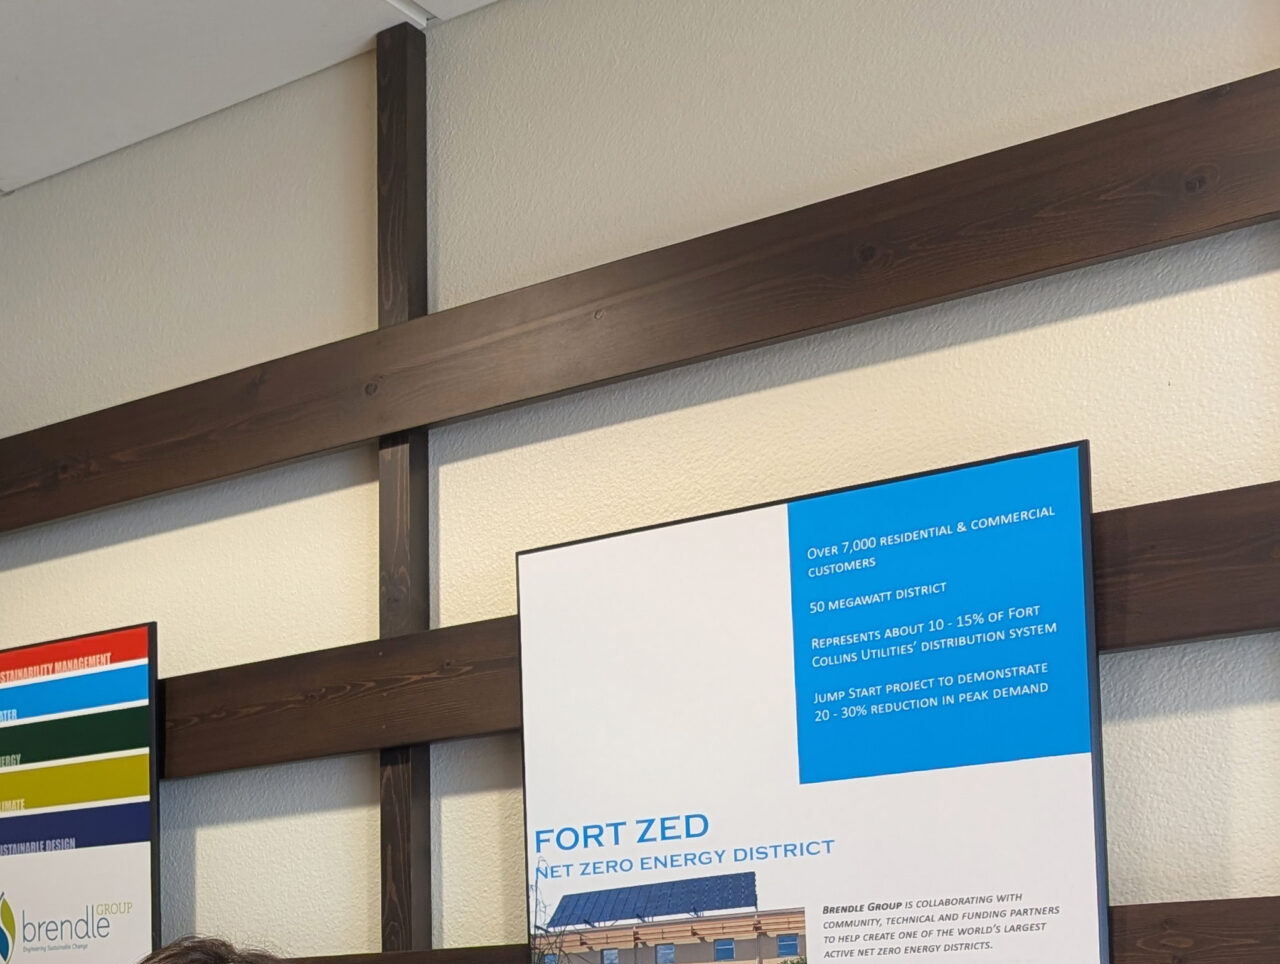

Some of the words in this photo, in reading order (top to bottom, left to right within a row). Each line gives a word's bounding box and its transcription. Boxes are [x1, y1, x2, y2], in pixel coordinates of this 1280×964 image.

[807, 545, 838, 559] OVER
[842, 536, 876, 553] 7,000
[879, 525, 953, 546] RESIDENTIAL
[956, 521, 967, 532] &
[970, 506, 1055, 530] COMMERCIAL
[808, 557, 876, 577] CUSTOMERS
[809, 600, 825, 614] 50
[828, 591, 892, 610] MEGAWATT
[895, 582, 946, 599] DISTRICT
[811, 630, 881, 649] REPRESENTS
[884, 623, 924, 638] ABOUT
[929, 618, 944, 632] 10
[956, 612, 984, 627] 15%
[987, 610, 1003, 622] OF
[1008, 605, 1040, 619] FORT
[812, 652, 858, 667] COLLINS
[861, 640, 916, 660] UTILITIES'
[921, 630, 1005, 651] DISTRIBUTION
[1009, 622, 1057, 638] SYSTEM
[55, 652, 111, 674] MANAGEMENT
[813, 690, 845, 704] JUMP
[848, 685, 882, 699] START
[885, 678, 934, 694] PROJECT
[937, 676, 954, 686] TO
[957, 662, 1047, 684] DEMONSTRATE
[815, 709, 830, 722] 20
[841, 704, 867, 718] 30%
[870, 697, 938, 714] REDUCTION
[942, 694, 954, 705] IN
[958, 690, 988, 702] PEAK
[992, 682, 1048, 699] DEMAND
[46, 838, 76, 852] DESIGN
[535, 821, 626, 853] FORT
[635, 813, 709, 843] ZED
[535, 863, 573, 881] NET
[579, 858, 633, 876] ZERO
[640, 849, 726, 870] ENERGY
[733, 839, 834, 862] DISTRICT
[96, 902, 132, 916] GROUP
[822, 904, 864, 914] BRENDLE
[867, 901, 902, 911] GROUP
[904, 900, 913, 909] IS
[915, 895, 993, 908] COLLABORATING
[996, 893, 1022, 902] WITH
[823, 918, 882, 929] COMMUNITY,
[886, 914, 935, 925] TECHNICAL
[937, 912, 959, 921] AND
[961, 909, 1006, 920] FUNDING
[1009, 905, 1060, 917] PARTNERS
[22, 904, 110, 942] brendle
[823, 935, 835, 944] TO
[837, 934, 860, 943] HELP
[862, 931, 895, 941] CREATE
[898, 930, 918, 939] ONE
[920, 929, 934, 938] OF
[936, 928, 954, 937] THE
[957, 924, 1000, 936] WORLD'S
[1003, 922, 1047, 933] LARGEST
[823, 949, 855, 958] ACTIVE
[857, 947, 875, 956] NET
[876, 946, 901, 956] ZERO
[903, 944, 941, 954] ENERGY
[943, 941, 992, 952] DISTRICTS.
